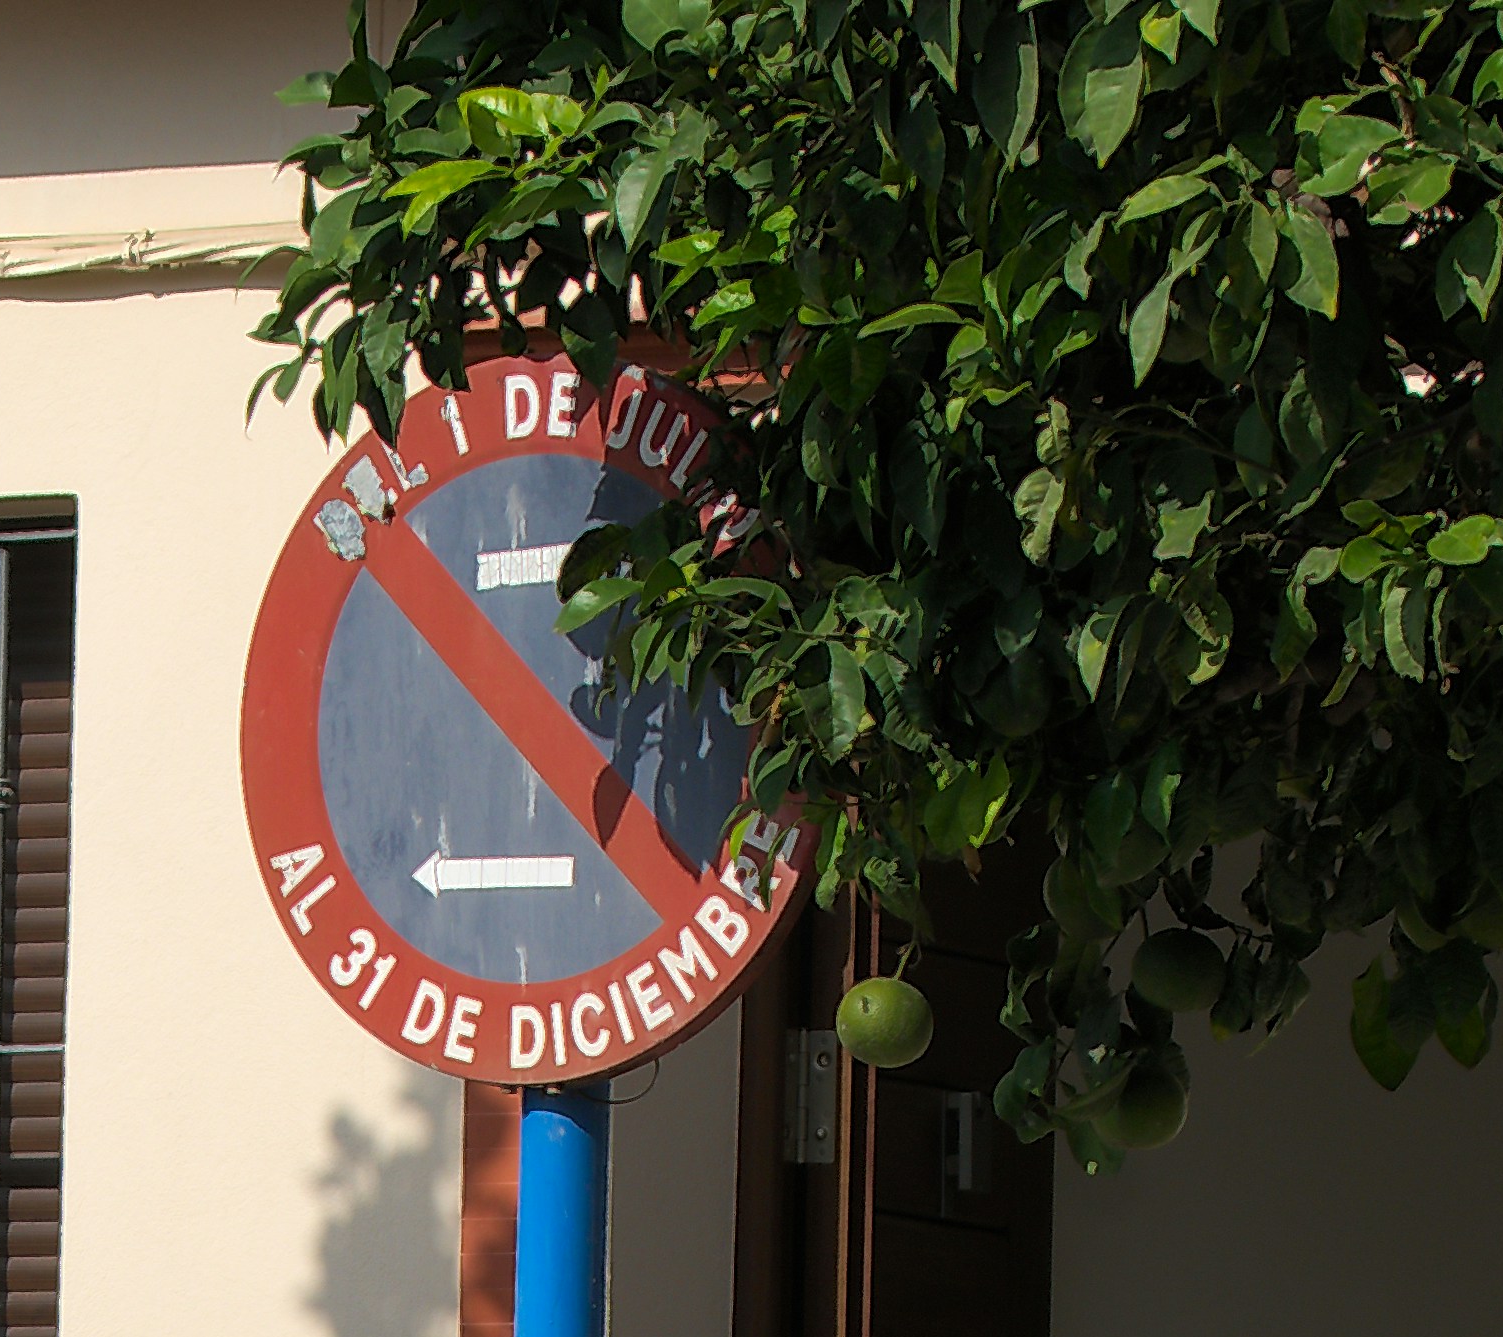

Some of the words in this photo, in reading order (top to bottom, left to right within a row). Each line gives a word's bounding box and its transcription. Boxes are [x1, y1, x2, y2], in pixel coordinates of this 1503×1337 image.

[439, 392, 470, 457] 1
[503, 370, 581, 441] DE
[270, 843, 338, 937] AL
[328, 927, 398, 1011] 31
[400, 977, 483, 1064] DE
[509, 808, 802, 1069] DICIEMBRE
